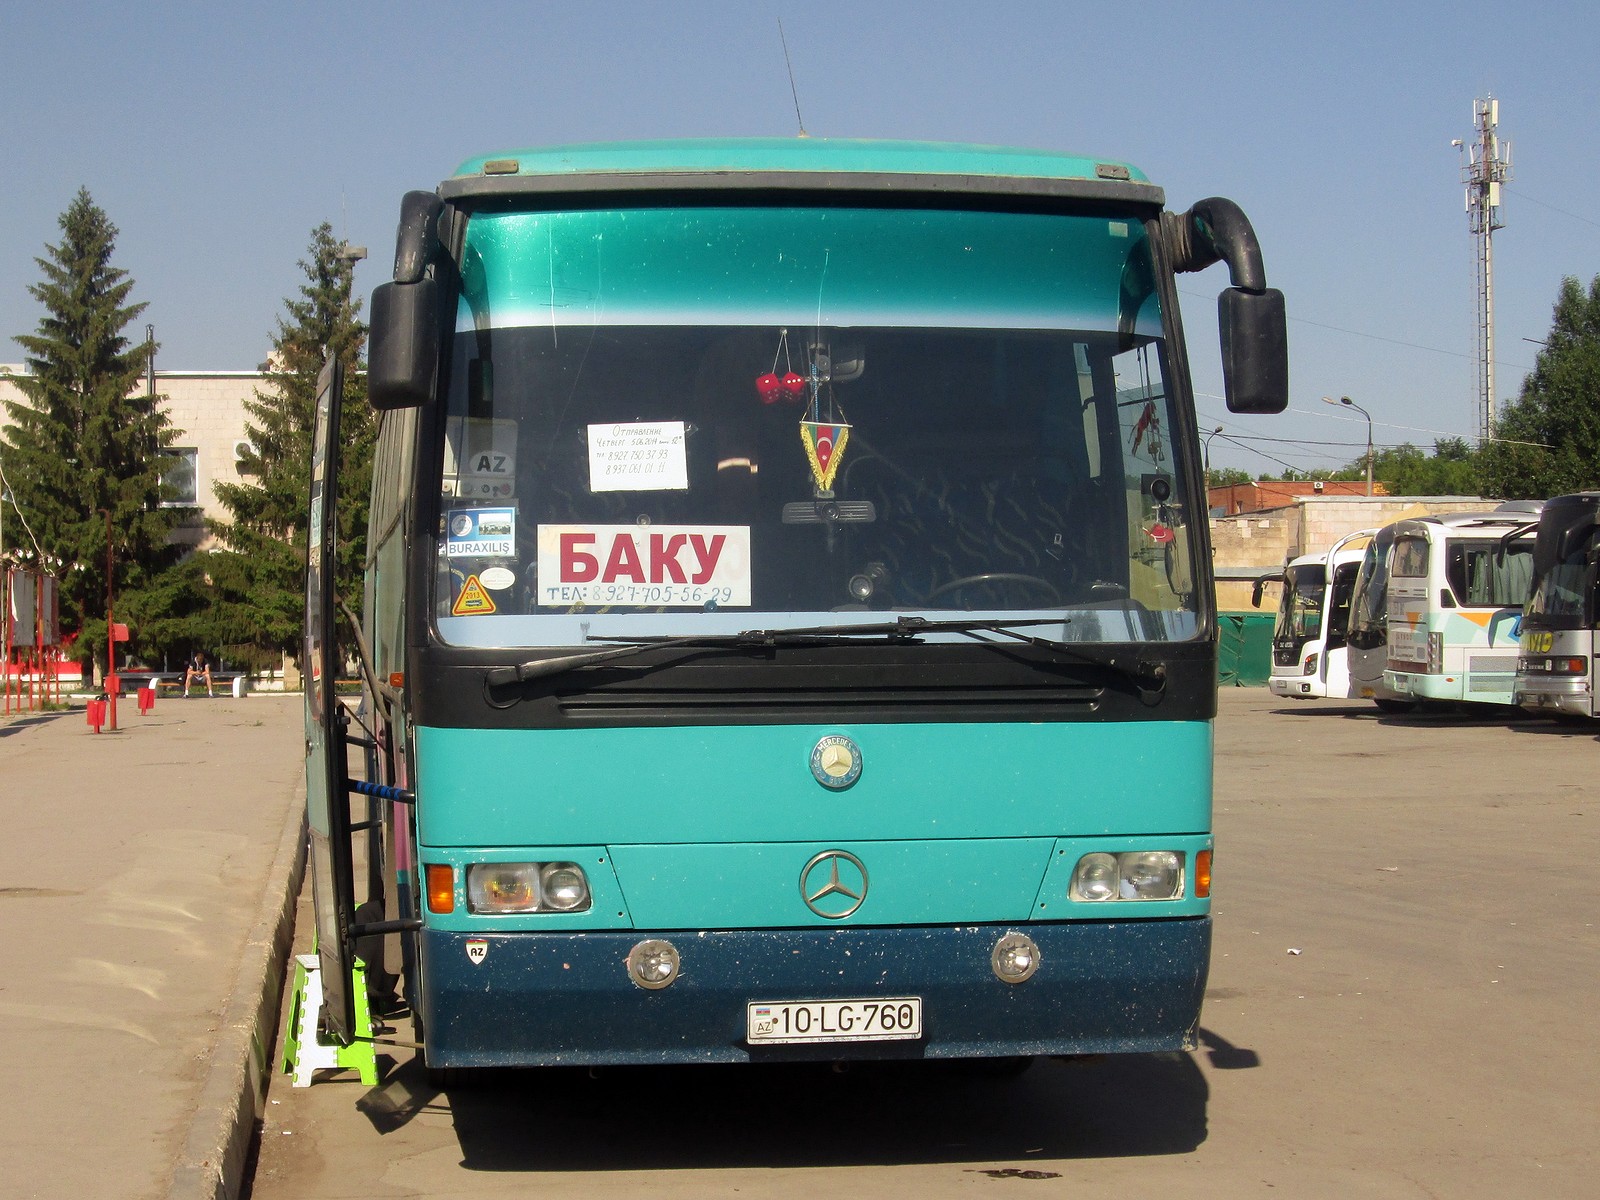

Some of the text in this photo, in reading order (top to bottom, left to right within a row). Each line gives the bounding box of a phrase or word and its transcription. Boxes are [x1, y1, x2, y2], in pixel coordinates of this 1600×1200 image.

[477, 455, 506, 473] AZ
[449, 542, 510, 555] BURAXILIŞ
[560, 533, 727, 585] БАКУ
[546, 586, 588, 601] ТЕЛ:
[817, 738, 852, 752] MERCEDES
[470, 947, 484, 957] AZ
[757, 1003, 914, 1034] AZ 10-LG-760
